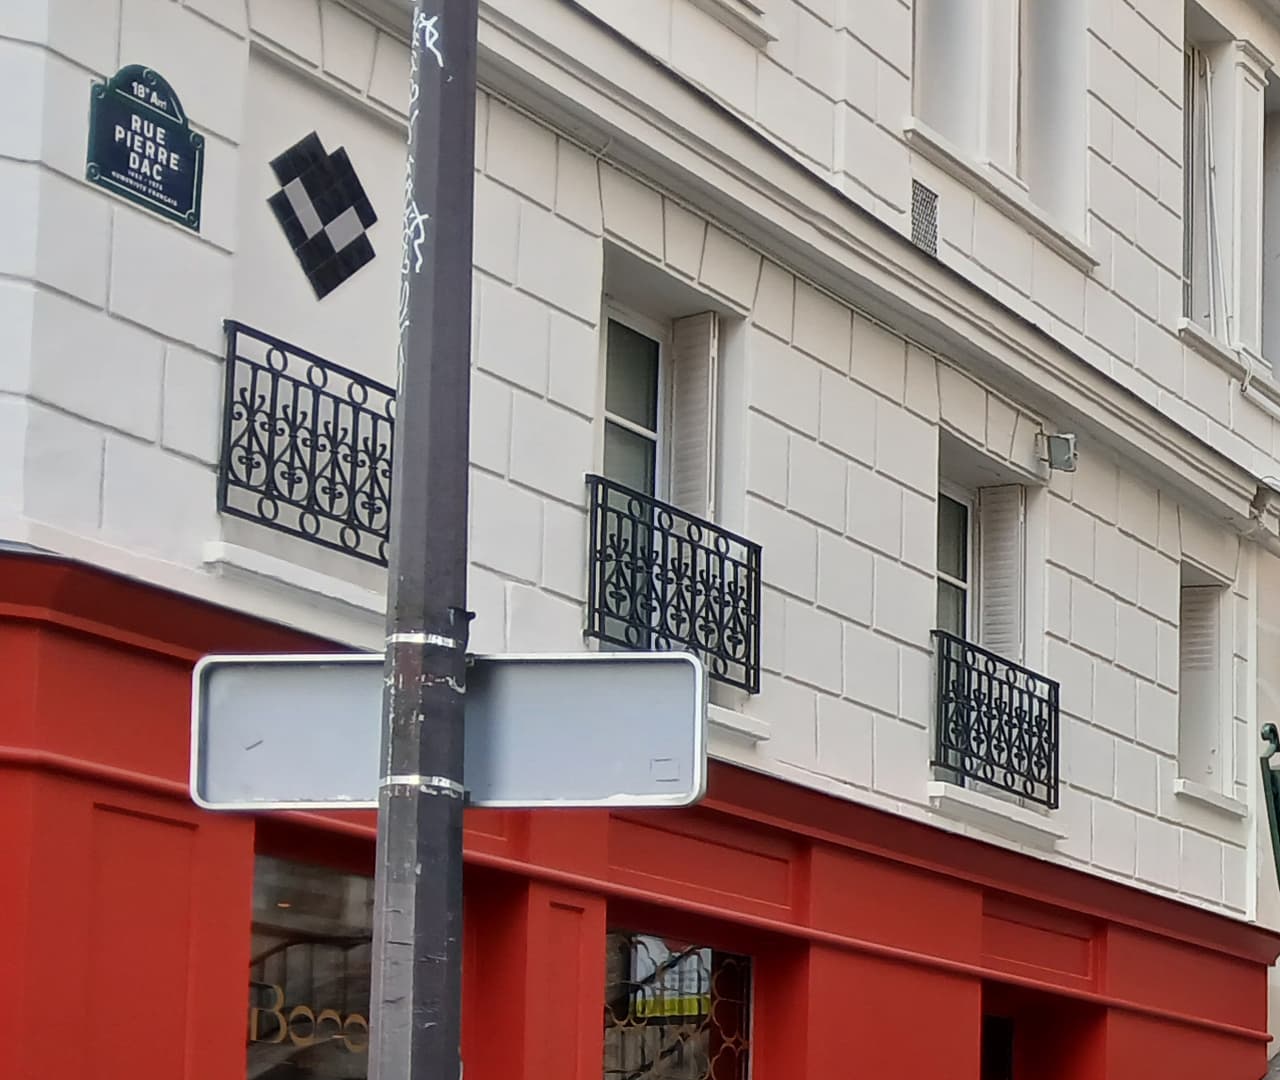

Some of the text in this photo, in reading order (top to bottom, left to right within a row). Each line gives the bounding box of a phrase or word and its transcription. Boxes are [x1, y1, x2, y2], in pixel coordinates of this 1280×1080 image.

[131, 114, 166, 145] RUE
[115, 125, 181, 171] PIERRE
[129, 152, 163, 180] DAC
